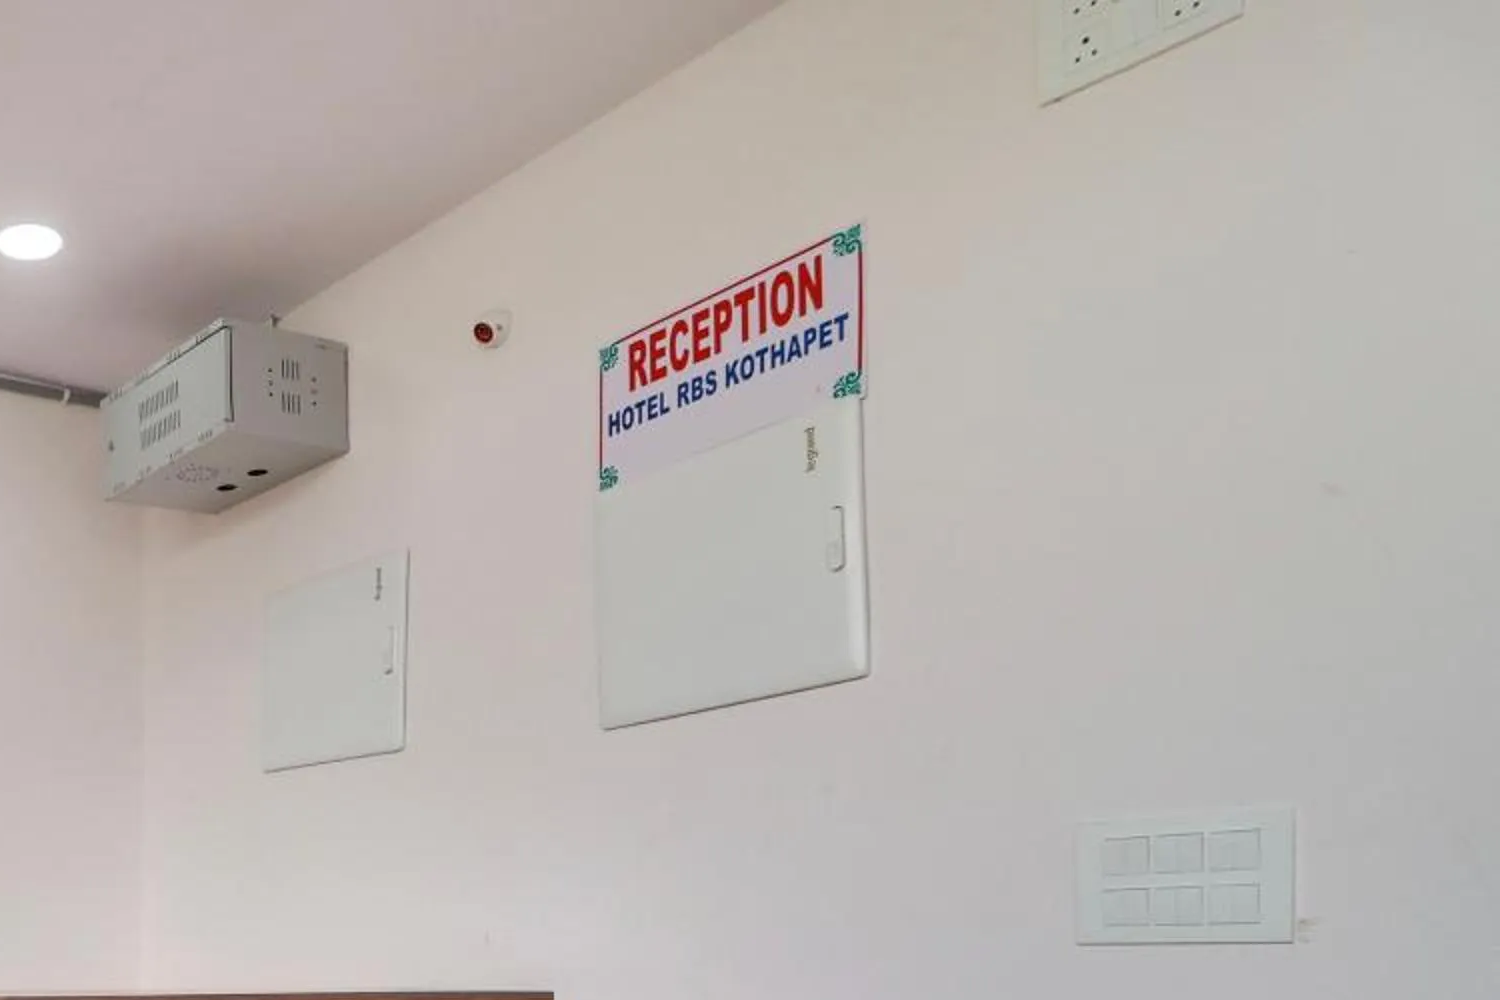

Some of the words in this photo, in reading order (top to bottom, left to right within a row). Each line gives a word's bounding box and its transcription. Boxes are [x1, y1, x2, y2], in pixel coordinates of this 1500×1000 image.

[607, 392, 670, 437] HOTEL
[677, 370, 717, 408] RBS
[725, 312, 849, 388] KOTHAPET
[628, 254, 823, 392] RECEPTION
